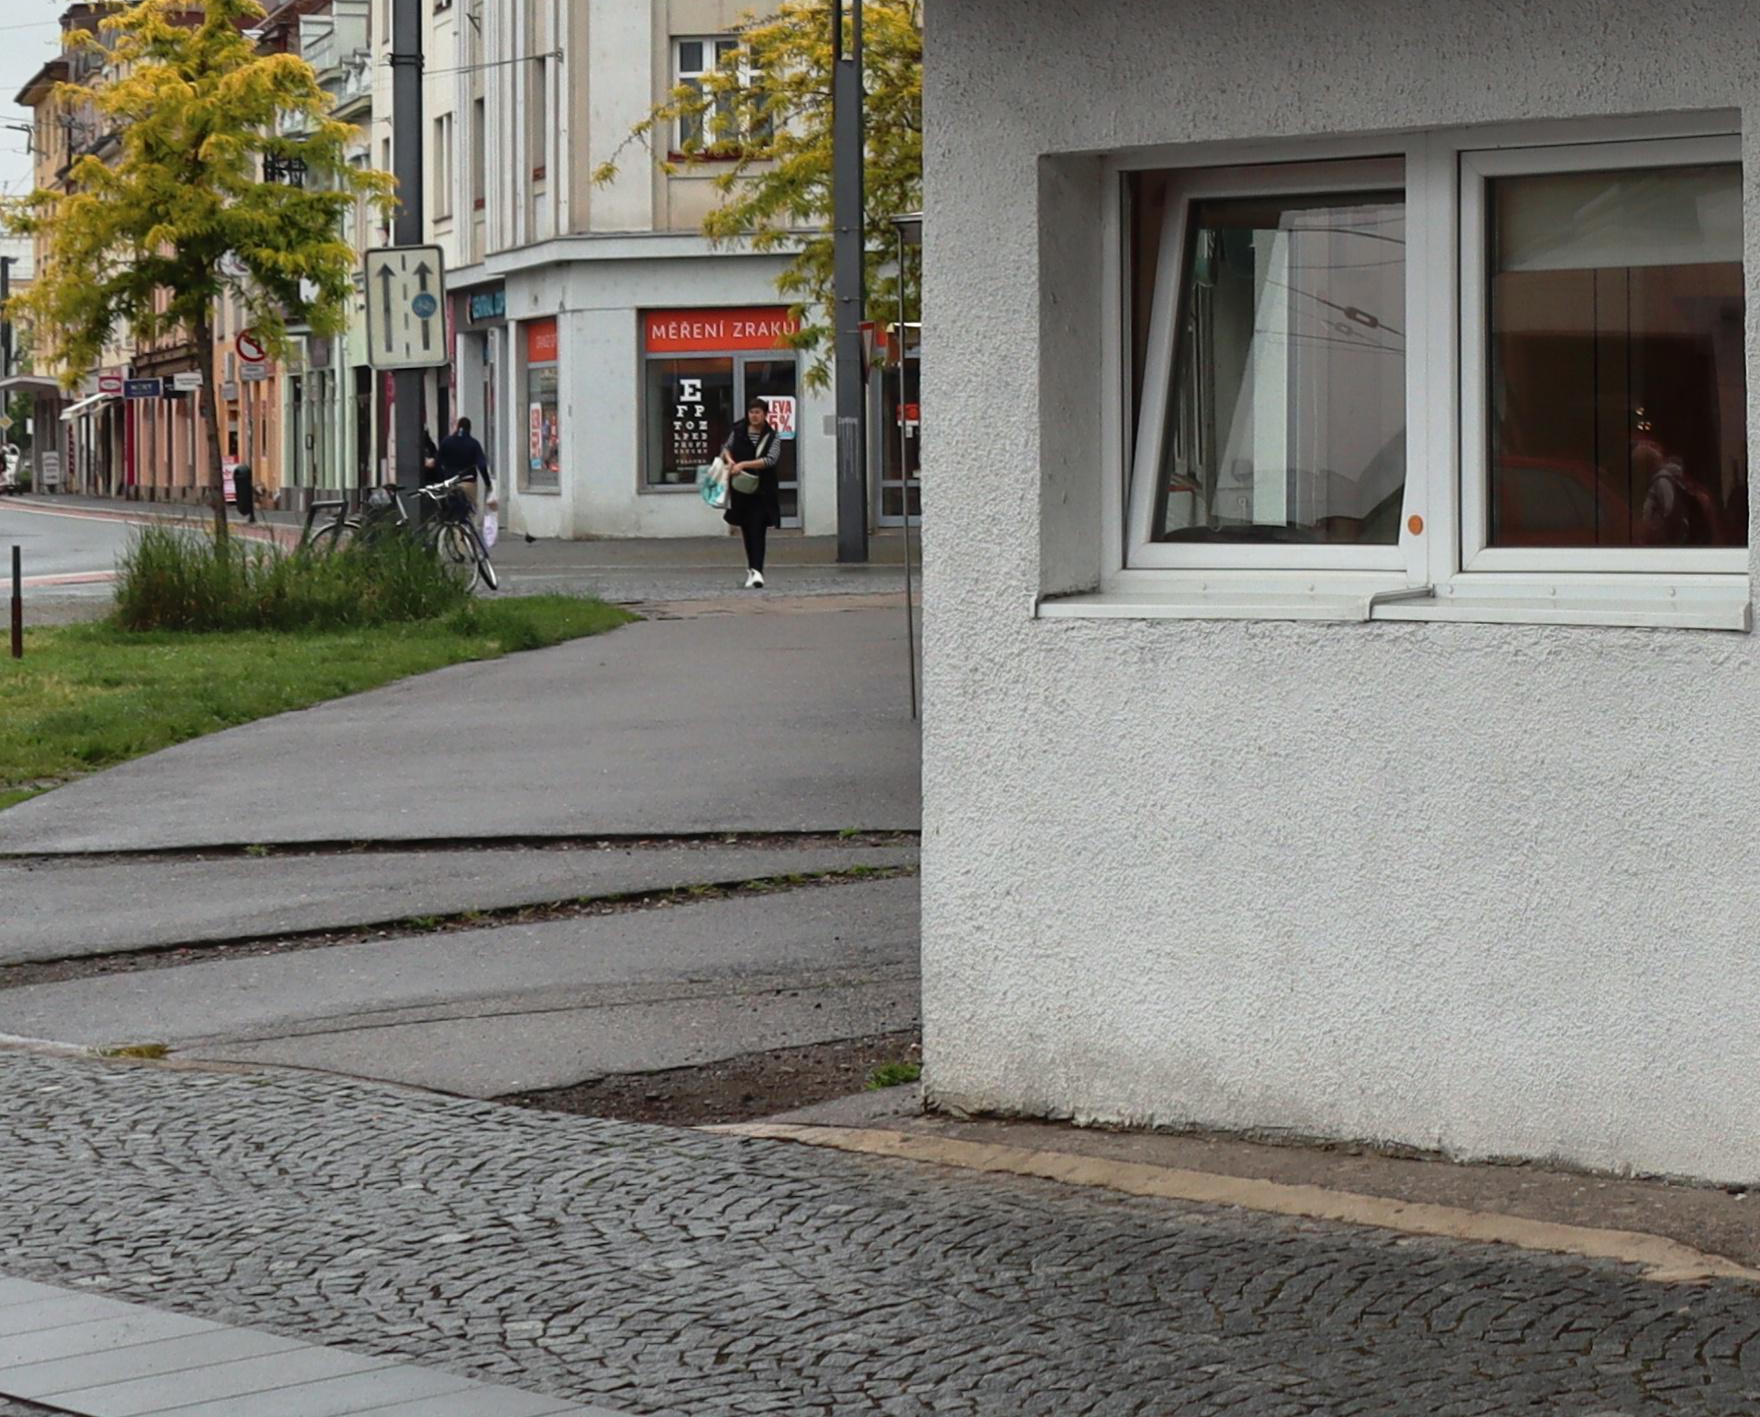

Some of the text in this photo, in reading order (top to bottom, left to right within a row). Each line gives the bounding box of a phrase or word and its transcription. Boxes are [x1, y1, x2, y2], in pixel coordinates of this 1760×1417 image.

[652, 320, 795, 340] MĚŘENÍ ZRAKU
[680, 379, 702, 402] E
